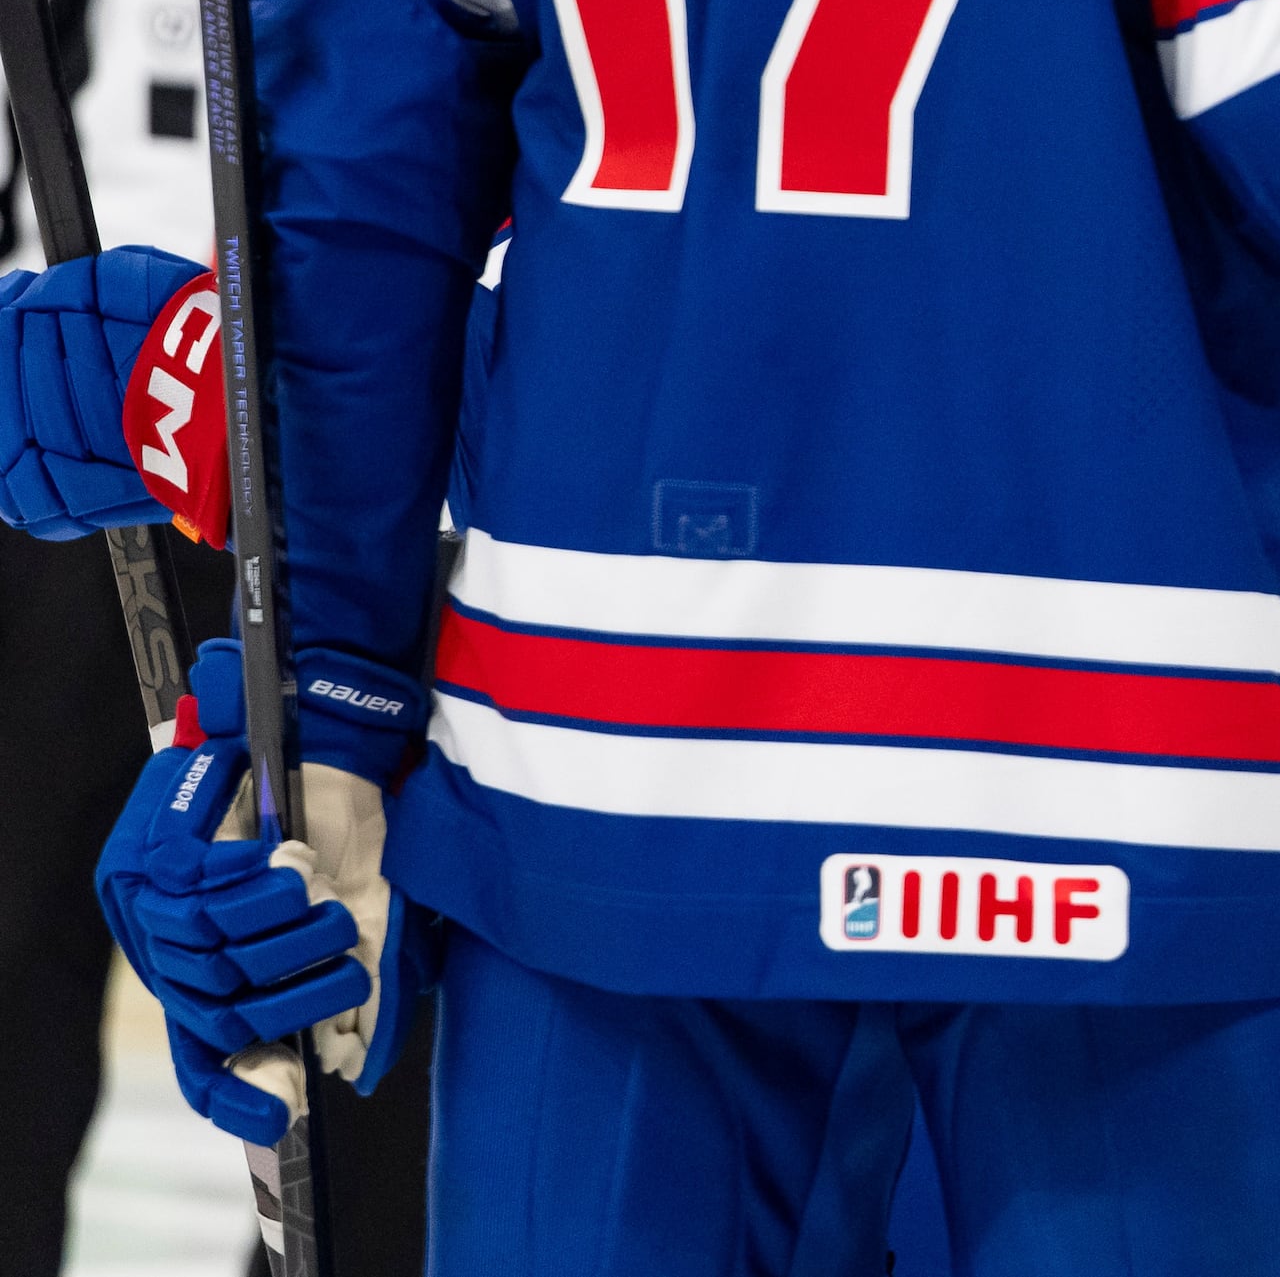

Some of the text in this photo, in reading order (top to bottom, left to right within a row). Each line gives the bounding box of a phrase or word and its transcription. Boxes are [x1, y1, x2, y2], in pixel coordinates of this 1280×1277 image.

[223, 86, 240, 166] RELEASE
[142, 284, 220, 493] CM
[225, 235, 255, 516] TWITCH TAPER TECHNOLOGY
[170, 753, 216, 813] BORGEN
[901, 869, 1100, 945] IIHF
